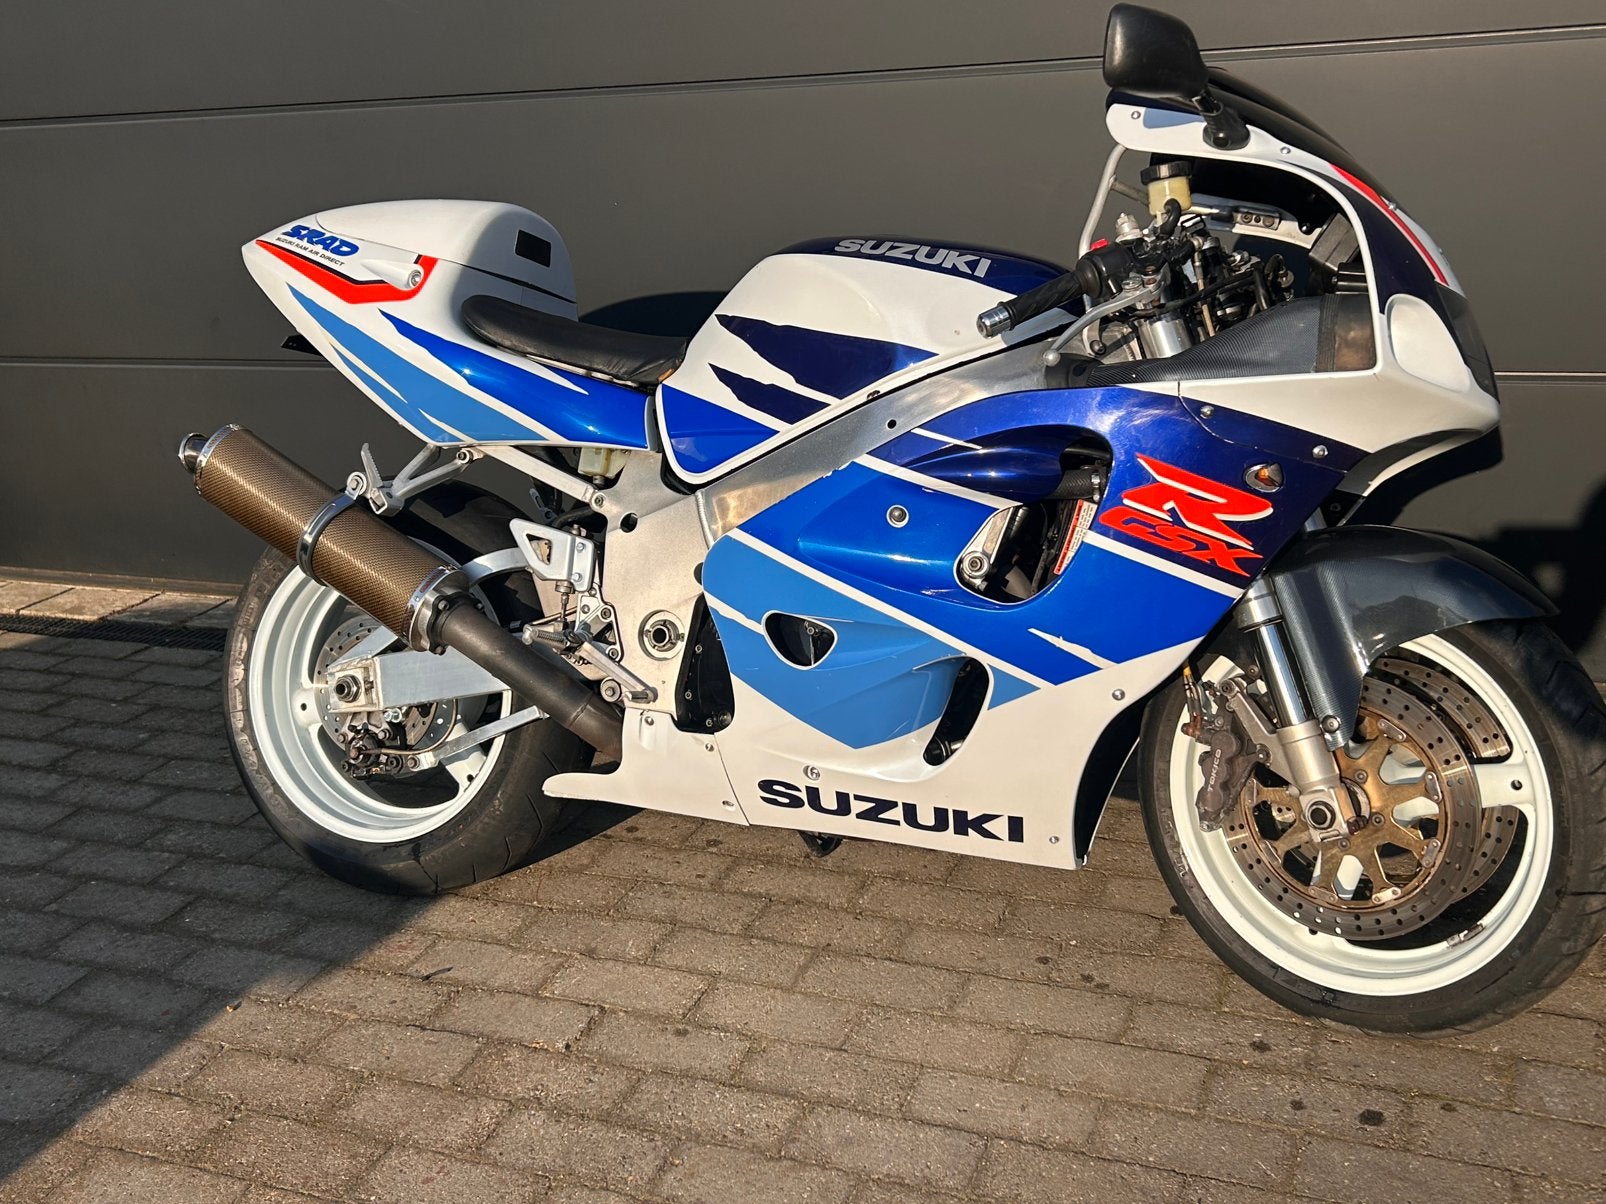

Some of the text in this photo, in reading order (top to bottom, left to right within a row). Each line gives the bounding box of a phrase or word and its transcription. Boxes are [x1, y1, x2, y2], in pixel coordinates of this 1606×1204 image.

[275, 236, 345, 267] SUZUKI RAM AIR DIRECT
[281, 225, 360, 256] SRAD
[834, 239, 992, 278] SUZUKI
[1121, 452, 1274, 551] R
[1098, 505, 1264, 578] GSX
[1207, 748, 1222, 792] TOKICO
[757, 779, 1025, 844] SUZUKI
